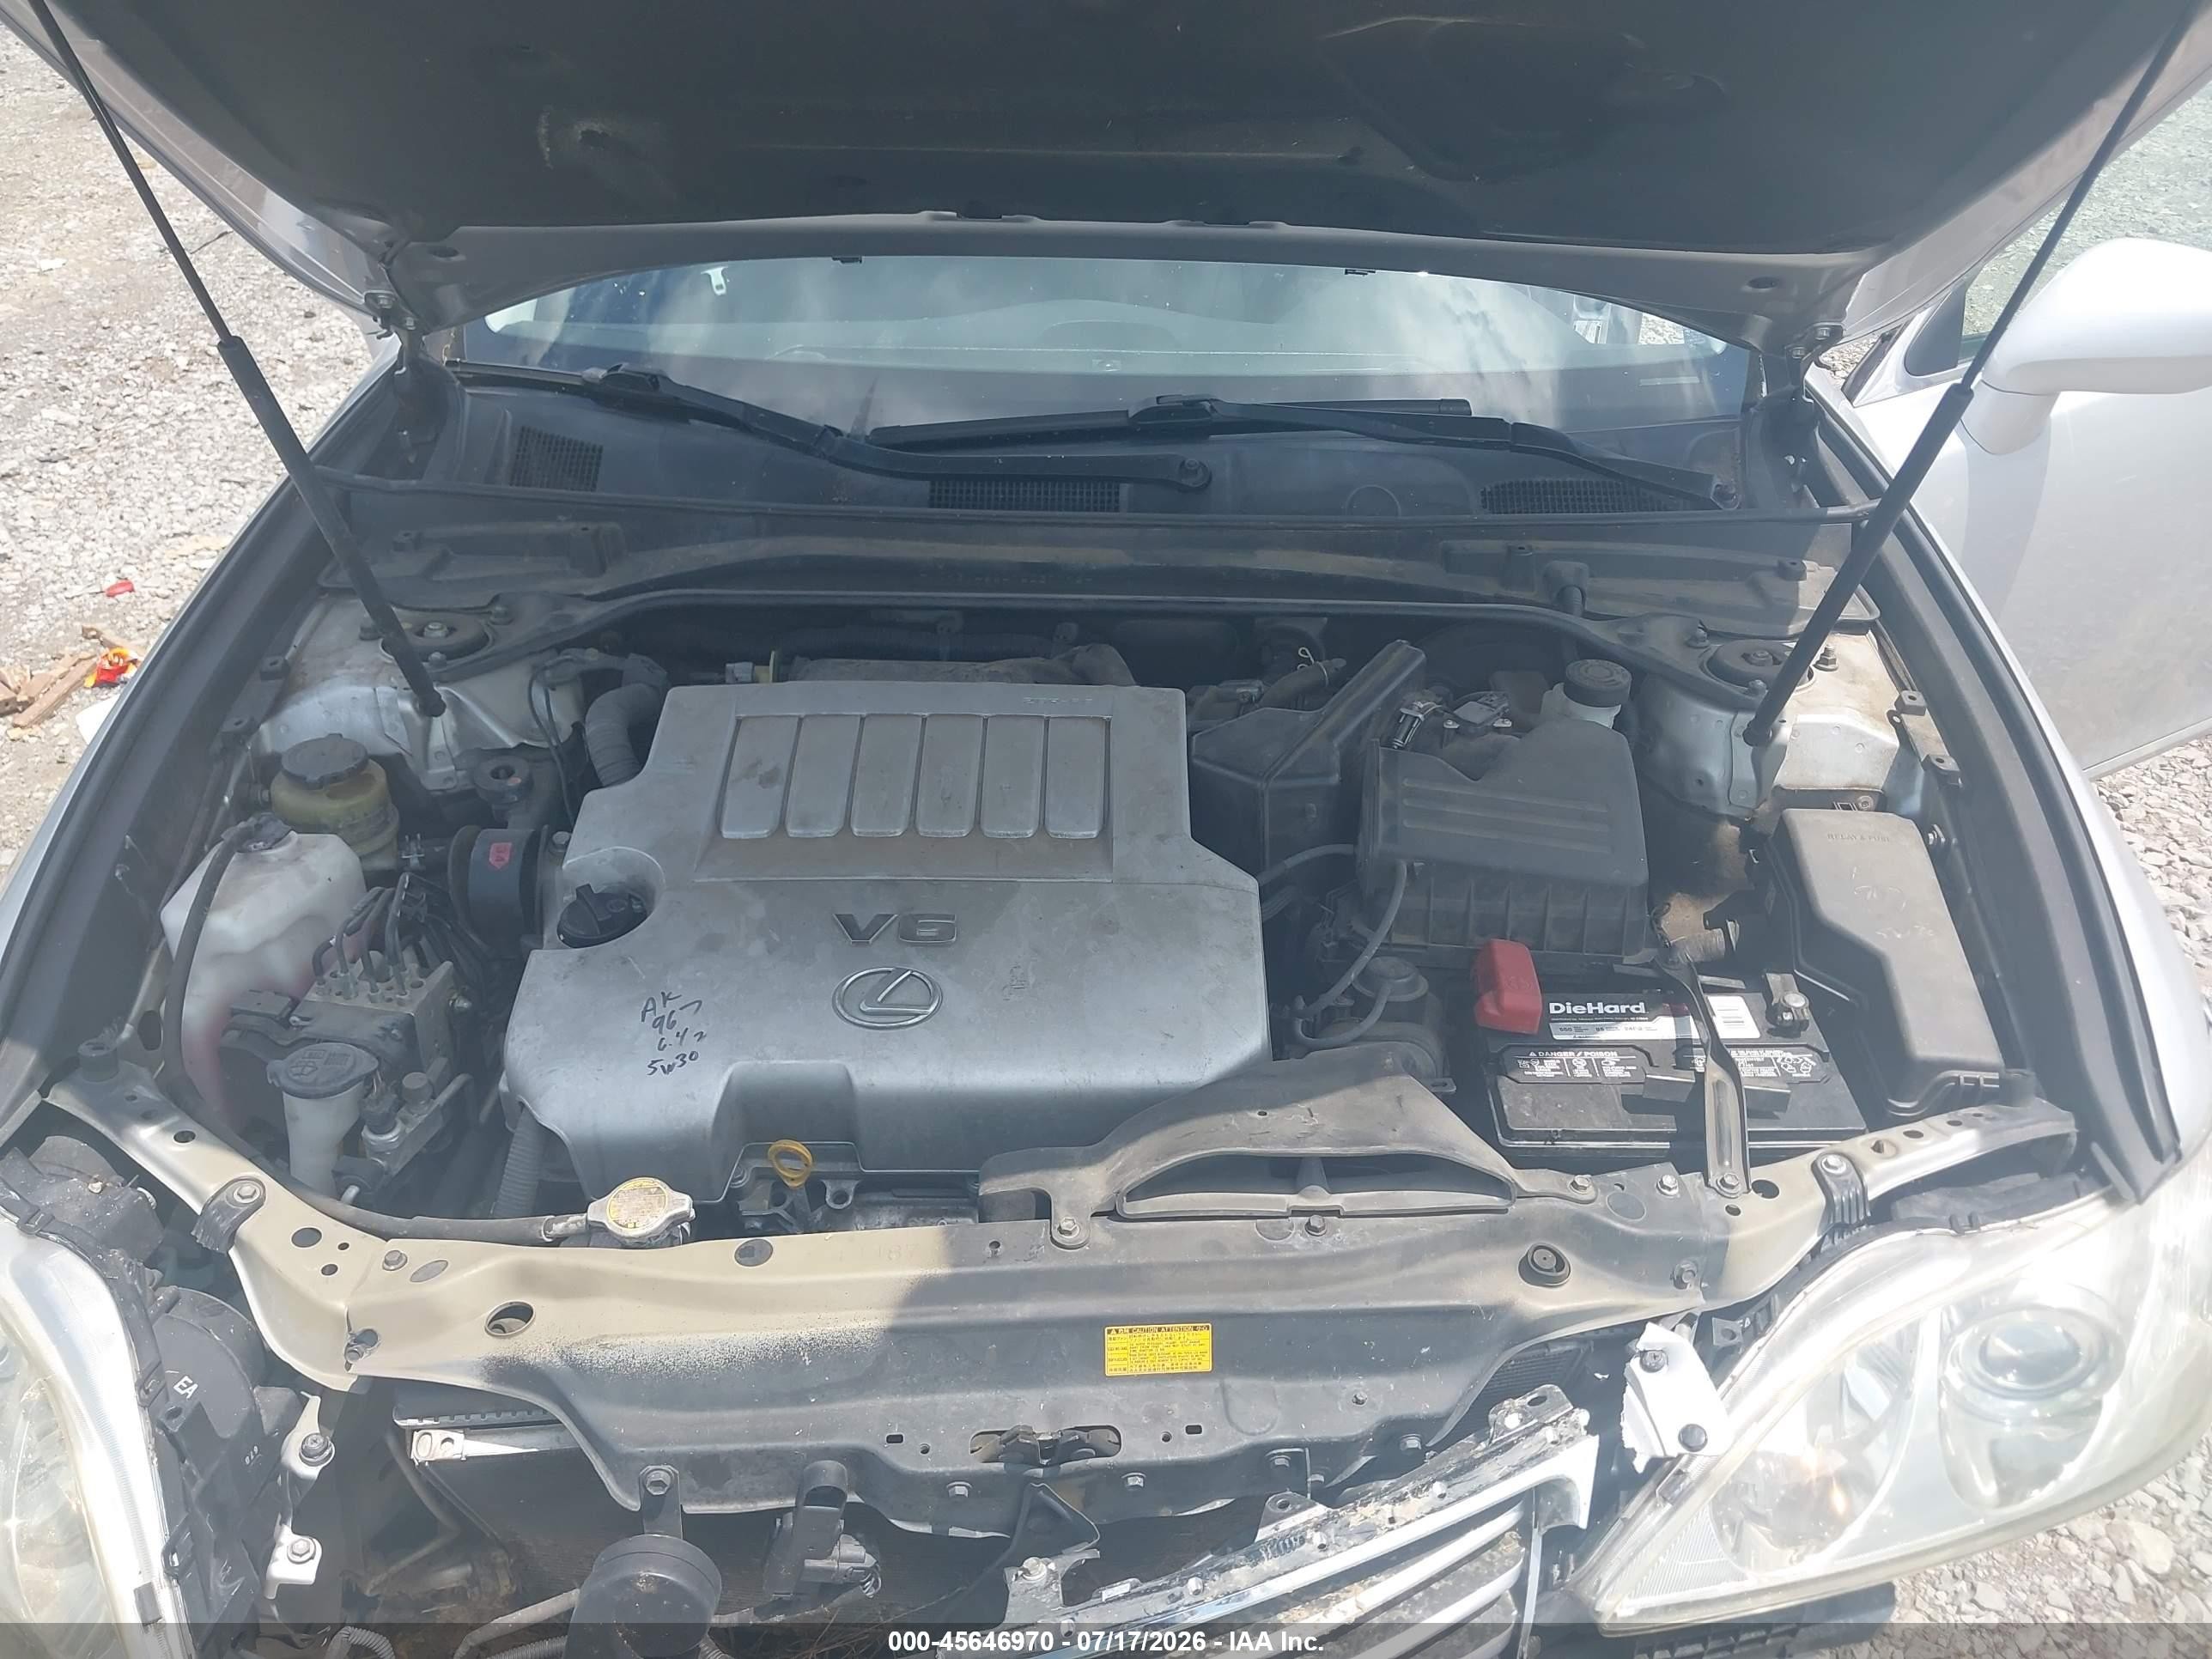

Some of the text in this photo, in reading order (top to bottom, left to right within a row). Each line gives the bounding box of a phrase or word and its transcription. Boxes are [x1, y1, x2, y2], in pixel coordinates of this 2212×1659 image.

[832, 912, 957, 945] V6
[1549, 1001, 1647, 1014] DieHard
[173, 1375, 199, 1400] EA
